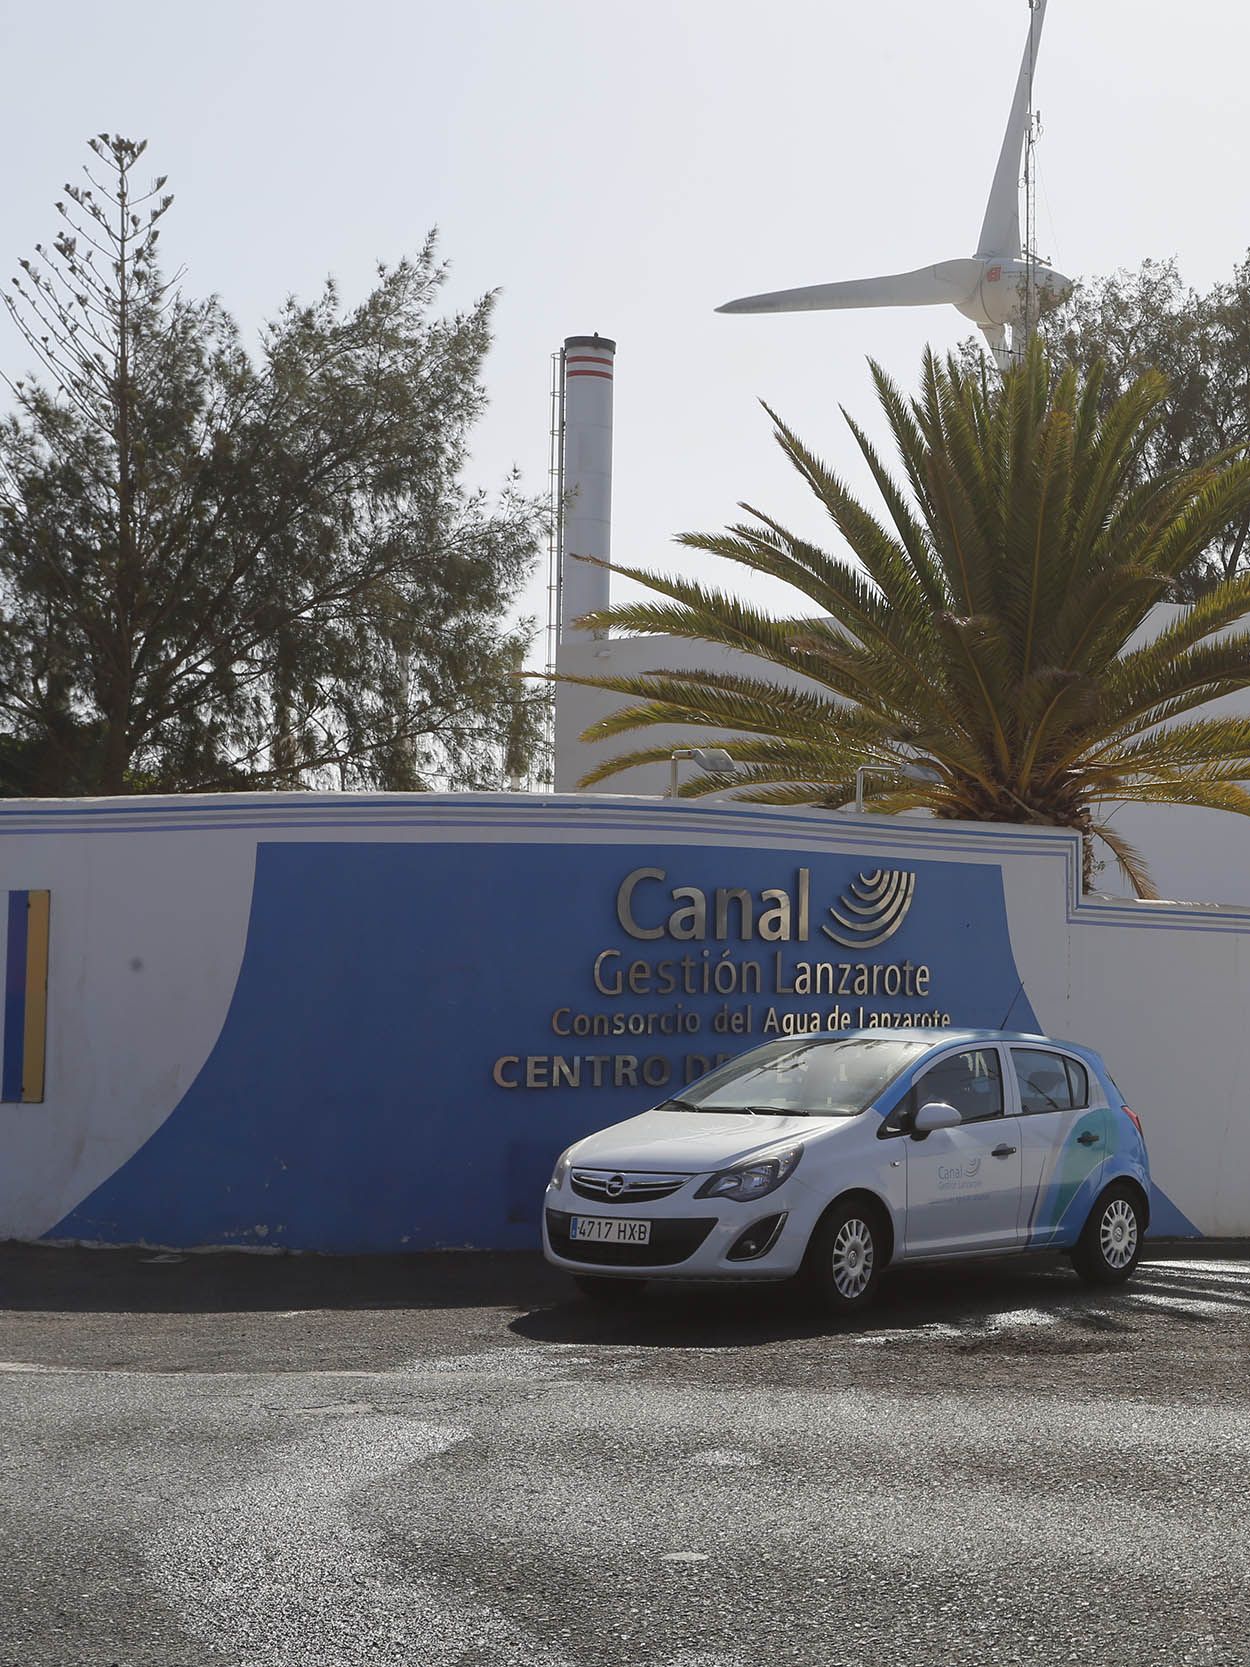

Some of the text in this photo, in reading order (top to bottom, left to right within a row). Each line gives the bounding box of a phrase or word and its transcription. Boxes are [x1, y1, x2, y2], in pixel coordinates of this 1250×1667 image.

[615, 866, 810, 943] Canal
[593, 949, 931, 998] Gestión Lanzarote
[551, 1003, 701, 1037] Consorcio
[713, 1003, 752, 1034] del
[764, 1007, 822, 1036] Agua
[827, 1005, 850, 1032] de
[492, 1055, 671, 1089] CENTRO
[938, 1166, 963, 1179] Canal
[578, 1220, 647, 1241] 4717 HXB
